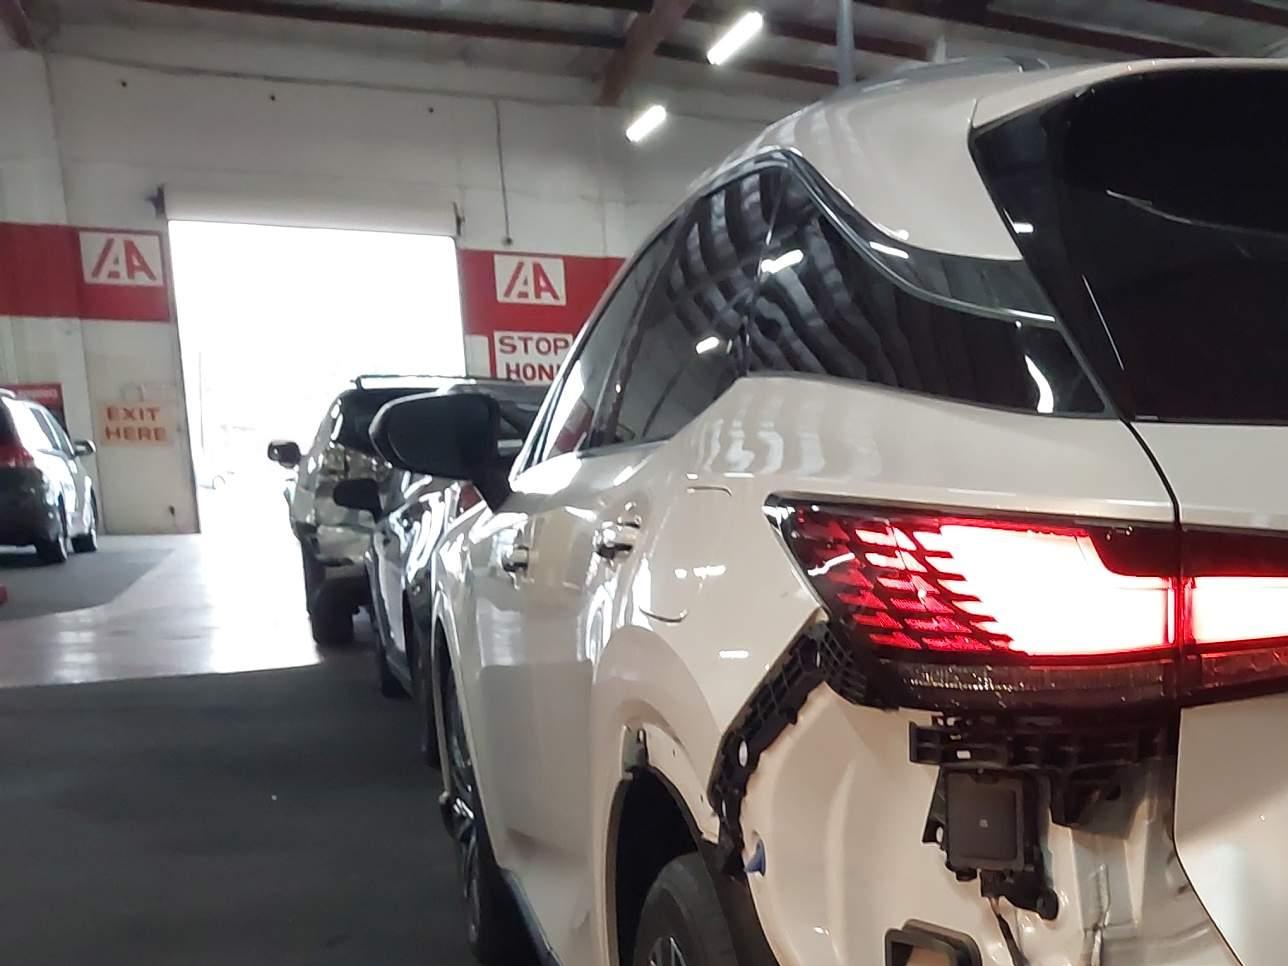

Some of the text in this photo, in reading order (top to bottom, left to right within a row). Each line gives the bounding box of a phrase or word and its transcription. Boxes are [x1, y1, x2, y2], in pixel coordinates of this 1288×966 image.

[498, 335, 570, 356] STOP
[506, 362, 561, 381] HON
[106, 406, 160, 422] EXIT
[104, 426, 168, 441] HERE
